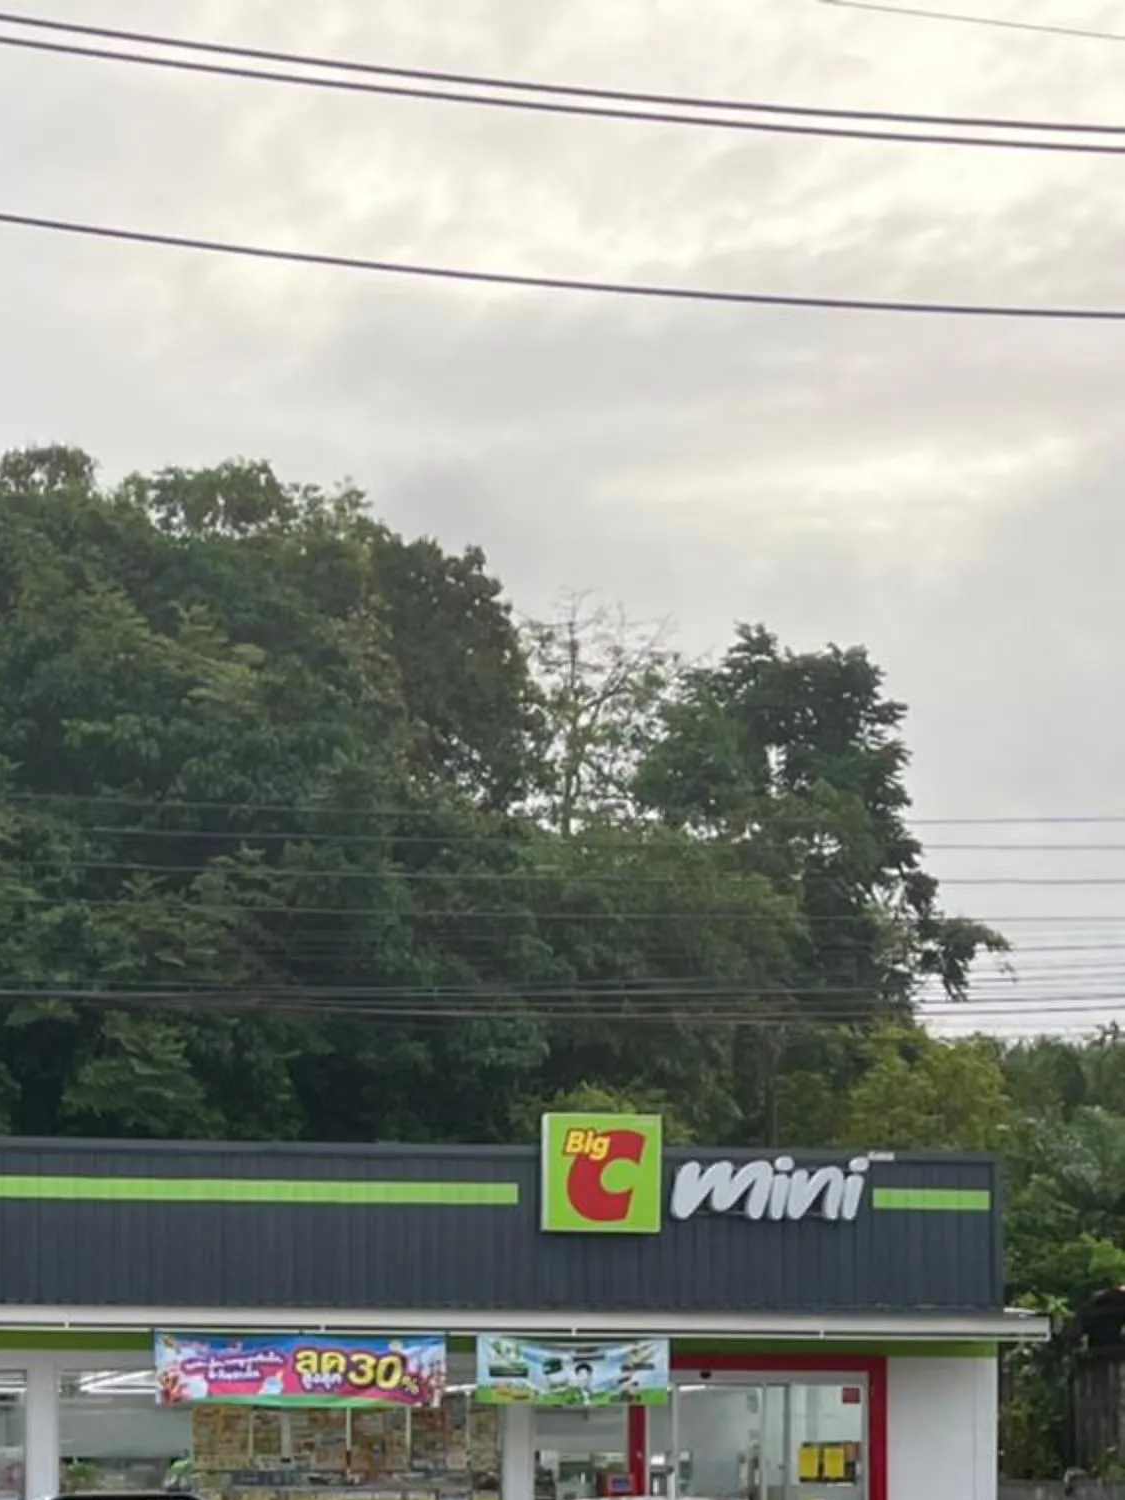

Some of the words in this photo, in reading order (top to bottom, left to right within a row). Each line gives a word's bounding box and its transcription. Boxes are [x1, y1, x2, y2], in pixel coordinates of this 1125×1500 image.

[565, 1130, 610, 1160] Big
[567, 1130, 646, 1221] C
[671, 1156, 869, 1220] mini
[295, 1350, 347, 1374] ลด
